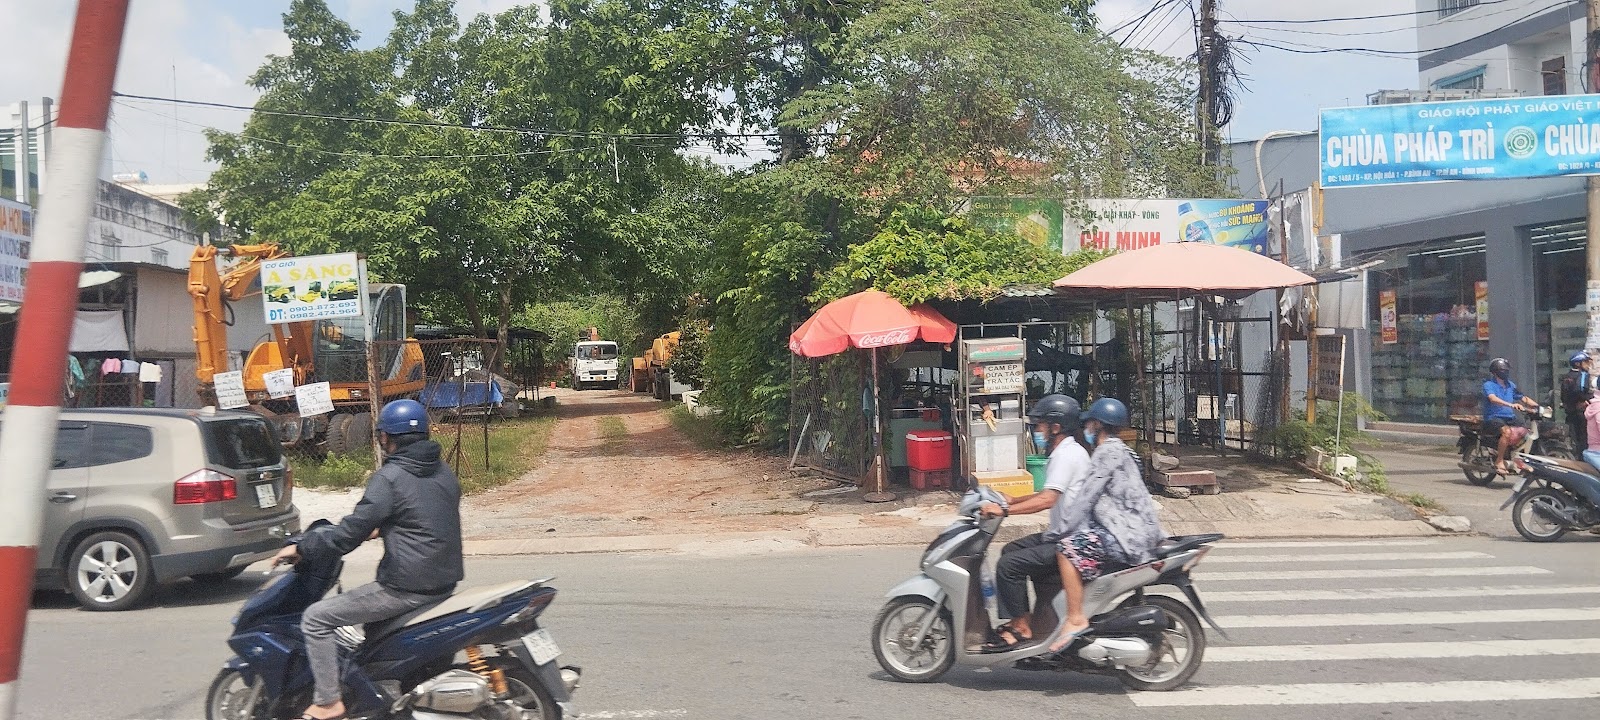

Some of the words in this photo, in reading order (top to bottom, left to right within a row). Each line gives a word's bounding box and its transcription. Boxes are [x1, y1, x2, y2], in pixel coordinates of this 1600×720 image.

[1418, 107, 1453, 118] GIÁO
[1455, 105, 1480, 117] HỘI
[1483, 103, 1520, 115] PHẬT
[1524, 101, 1559, 113] GIÁO
[1562, 100, 1593, 112] VIỆT
[1326, 128, 1389, 168] CHÙA
[1393, 124, 1453, 163] PHÁP
[1459, 121, 1495, 161] TRÌ
[1544, 117, 1600, 157] CHÙA
[267, 271, 283, 283] A
[288, 263, 353, 282] SÁNG
[858, 328, 912, 348] Coca-Cola
